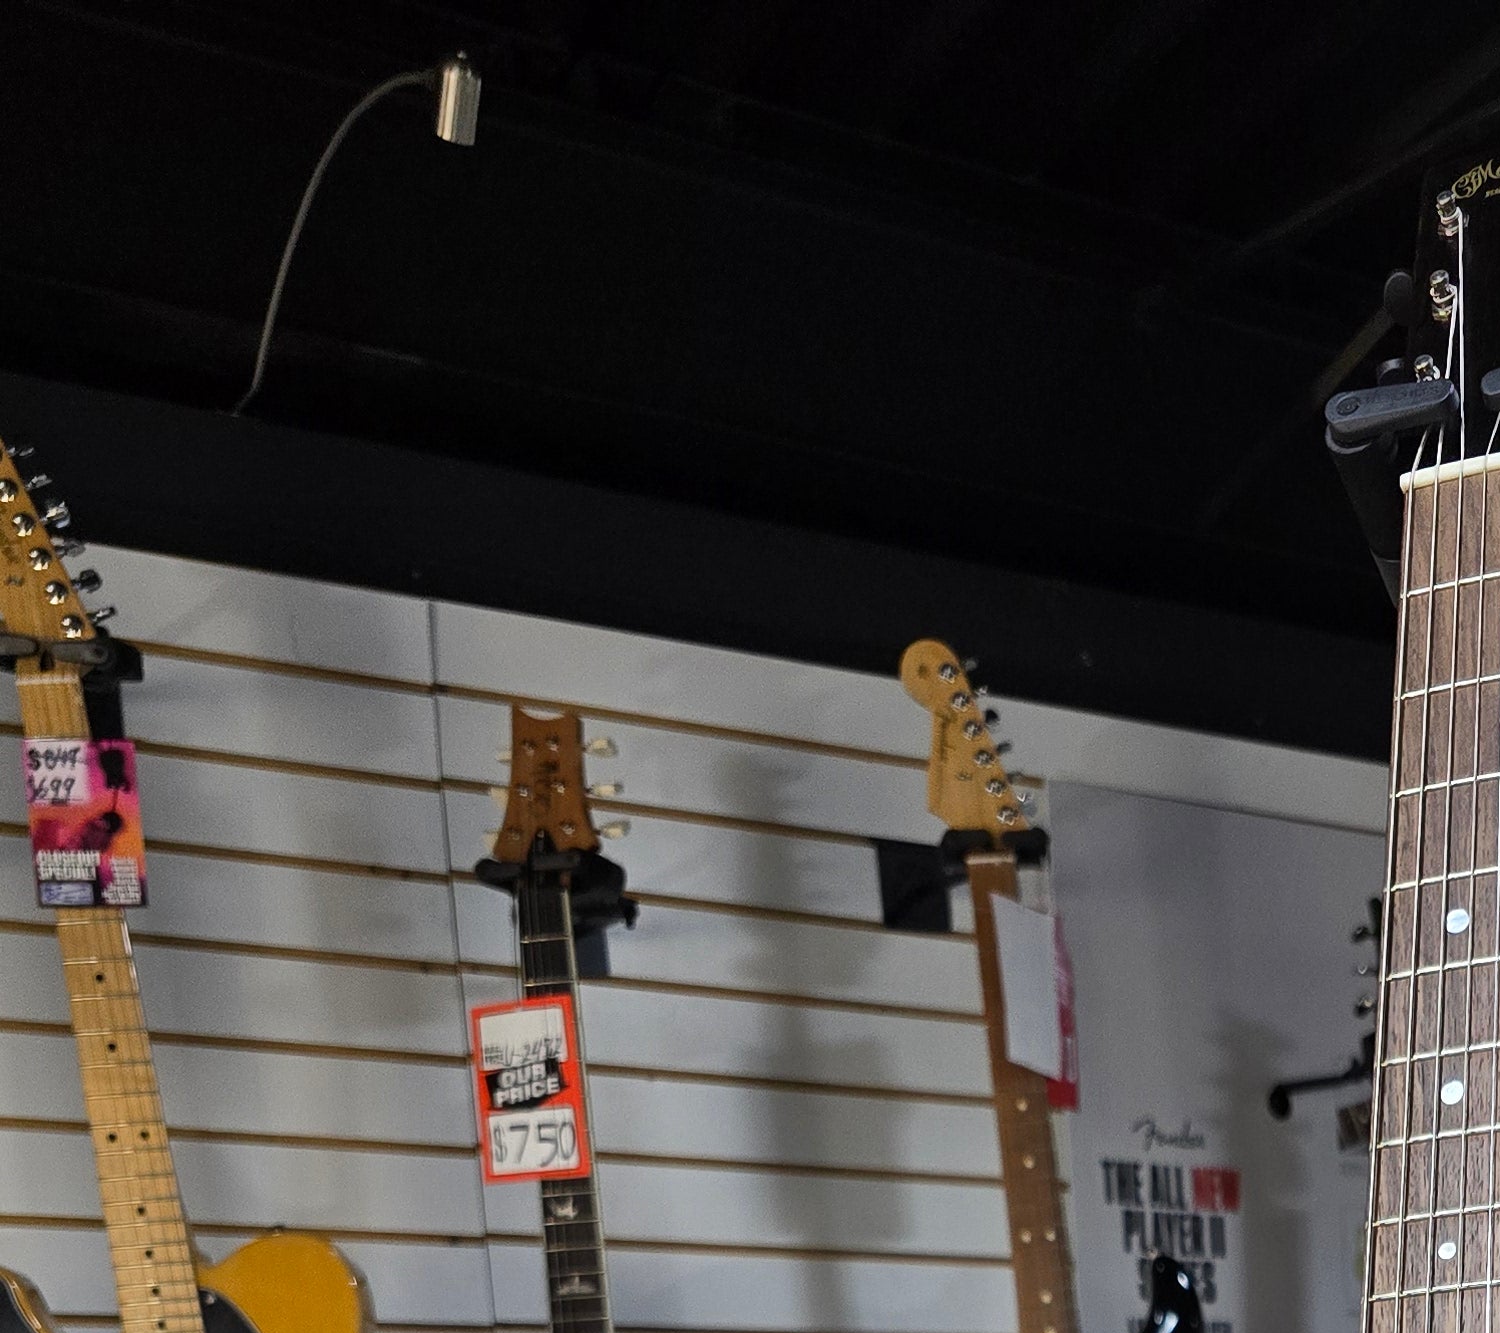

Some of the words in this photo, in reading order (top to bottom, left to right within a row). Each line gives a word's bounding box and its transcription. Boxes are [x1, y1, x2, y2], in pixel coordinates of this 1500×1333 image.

[494, 1078, 560, 1108] PRICE
[501, 1063, 546, 1088] OUR
[493, 1121, 576, 1168] $750
[1102, 1159, 1141, 1207] THE
[1151, 1164, 1185, 1211] ALL
[1123, 1210, 1205, 1258] PLAYER
